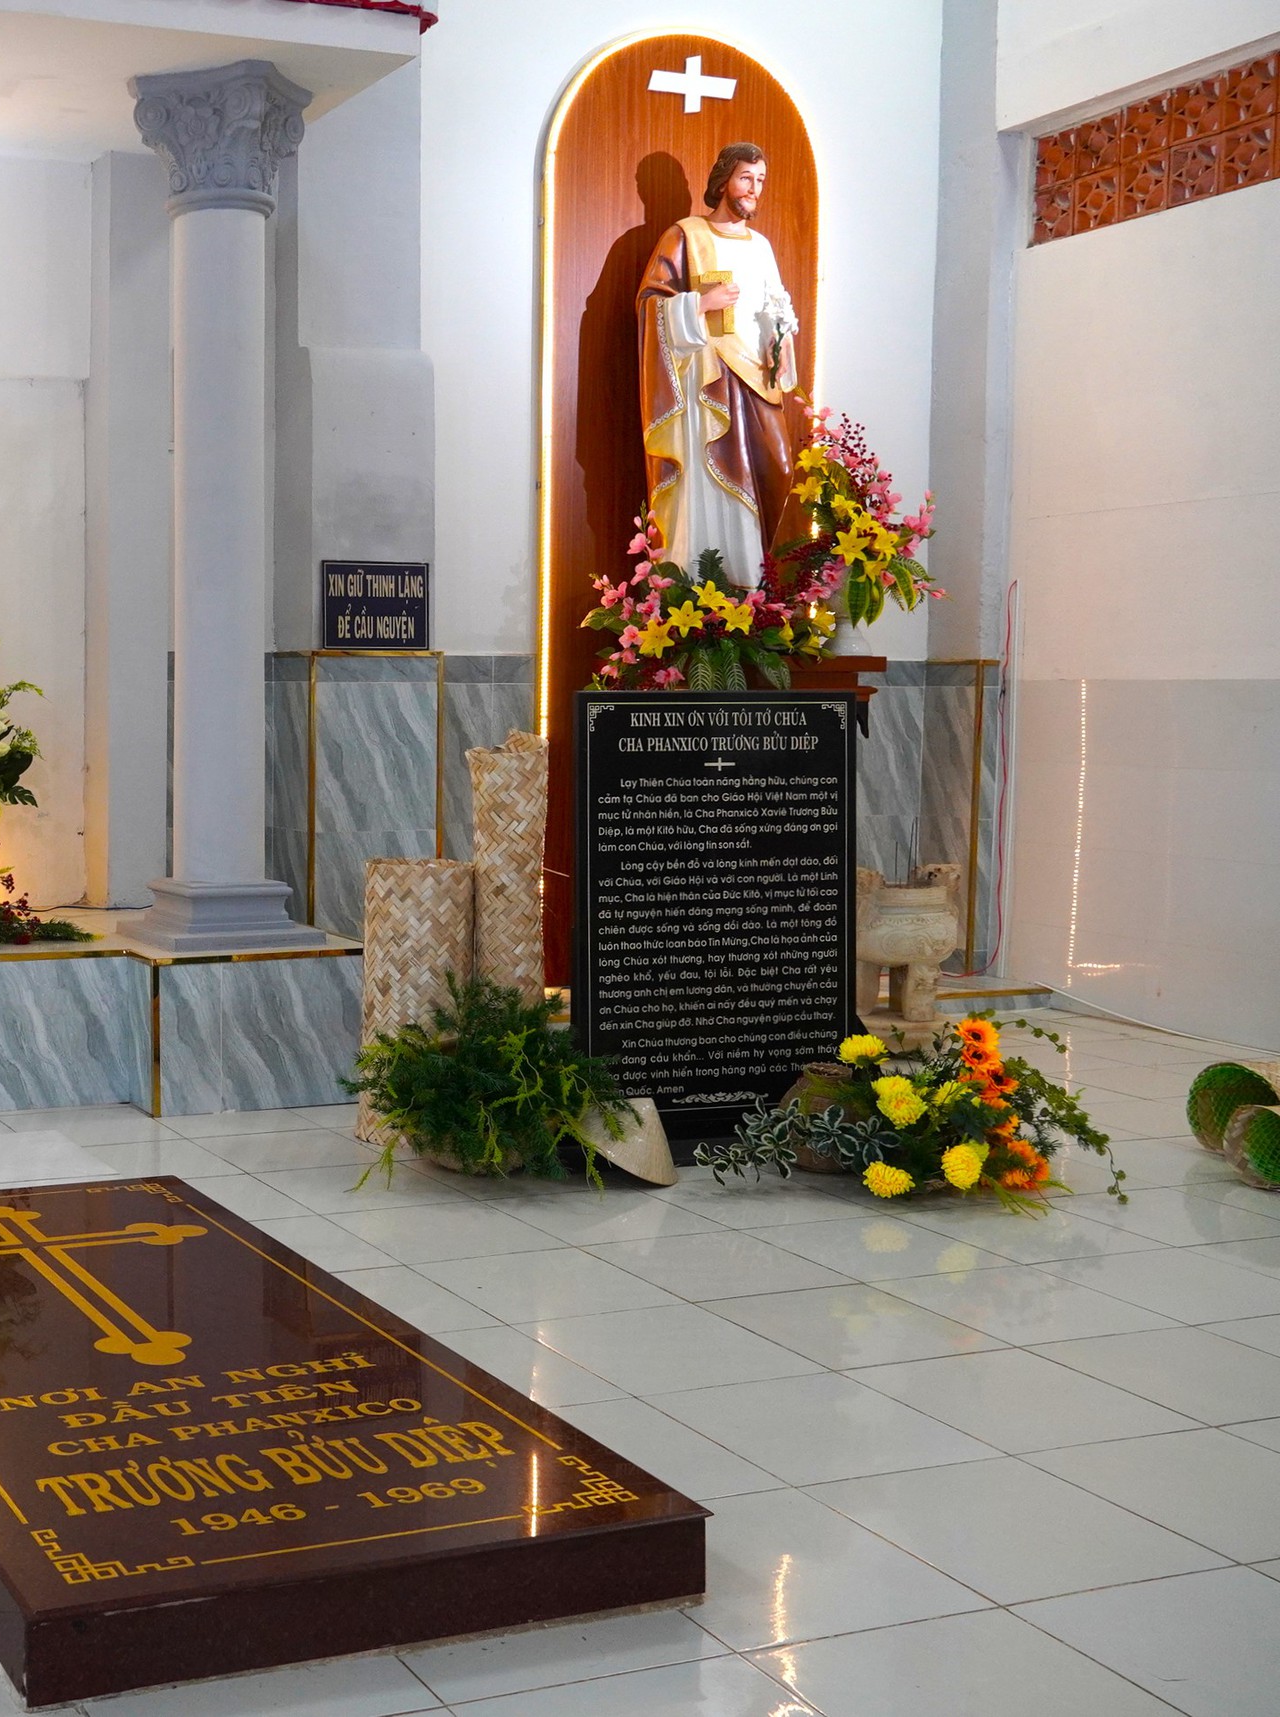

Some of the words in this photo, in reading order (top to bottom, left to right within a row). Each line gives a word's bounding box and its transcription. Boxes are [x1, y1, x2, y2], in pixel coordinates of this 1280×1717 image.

[328, 574, 344, 597] XIN
[347, 568, 364, 597] GIỮ
[366, 575, 395, 598] THINH
[398, 570, 424, 604] LẶNG
[338, 603, 352, 639] ĐỂ
[354, 606, 374, 639] CẦU
[376, 610, 415, 644] NGUYỆN
[631, 713, 660, 726] KINH
[664, 713, 684, 726] XIN
[688, 710, 705, 726] ƠN
[708, 708, 728, 726] VỚI
[732, 708, 752, 726] TÔI
[755, 708, 771, 726] TỚ
[774, 708, 806, 726] CHÚA
[619, 738, 643, 752] CHA
[647, 737, 708, 752] PHANXICO
[711, 734, 759, 751] TRƯƠNG
[763, 731, 787, 750] BỬU
[791, 732, 818, 753] DIỆP
[621, 779, 637, 789] Lạy
[639, 778, 664, 787] Thiên
[666, 778, 691, 787] Chúa
[693, 777, 715, 786] toàn
[789, 776, 819, 787] chúng
[820, 776, 838, 784] con
[623, 795, 633, 805] tạ
[636, 794, 662, 803] Chúa
[664, 793, 677, 802] đã
[680, 793, 699, 802] ban
[701, 793, 719, 802] cho
[722, 792, 745, 801] Giáo
[786, 791, 807, 800] Nam
[830, 791, 838, 801] vị
[598, 812, 620, 821] mục
[633, 810, 657, 819] nhân
[684, 809, 693, 818] là
[695, 809, 715, 818] Cha
[717, 808, 759, 817] Phanxicô
[761, 807, 787, 816] Xaviê
[789, 807, 819, 818] Trương
[598, 843, 617, 852] làm
[618, 843, 637, 851] con
[684, 841, 705, 852] lòng
[706, 840, 717, 849] tin
[718, 841, 734, 849] son
[599, 958, 620, 969] lòng
[623, 956, 649, 966] Chúa
[652, 955, 667, 964] xót
[708, 954, 725, 964] hay
[728, 952, 760, 963] thương
[763, 951, 778, 960] xót
[656, 1085, 685, 1094] Amen
[127, 1375, 206, 1397] AN
[221, 1352, 376, 1384] NGHỈ
[57, 1401, 193, 1428] ĐẦU
[211, 1380, 360, 1408] TIÊN
[47, 1432, 163, 1456] CHA
[167, 1398, 422, 1442] PHANXICO
[35, 1454, 275, 1516] TRƯƠNG
[260, 1430, 389, 1485] BỬU
[373, 1416, 515, 1469] DIỆP
[170, 1503, 307, 1536] 1946
[357, 1478, 487, 1509] 1969
